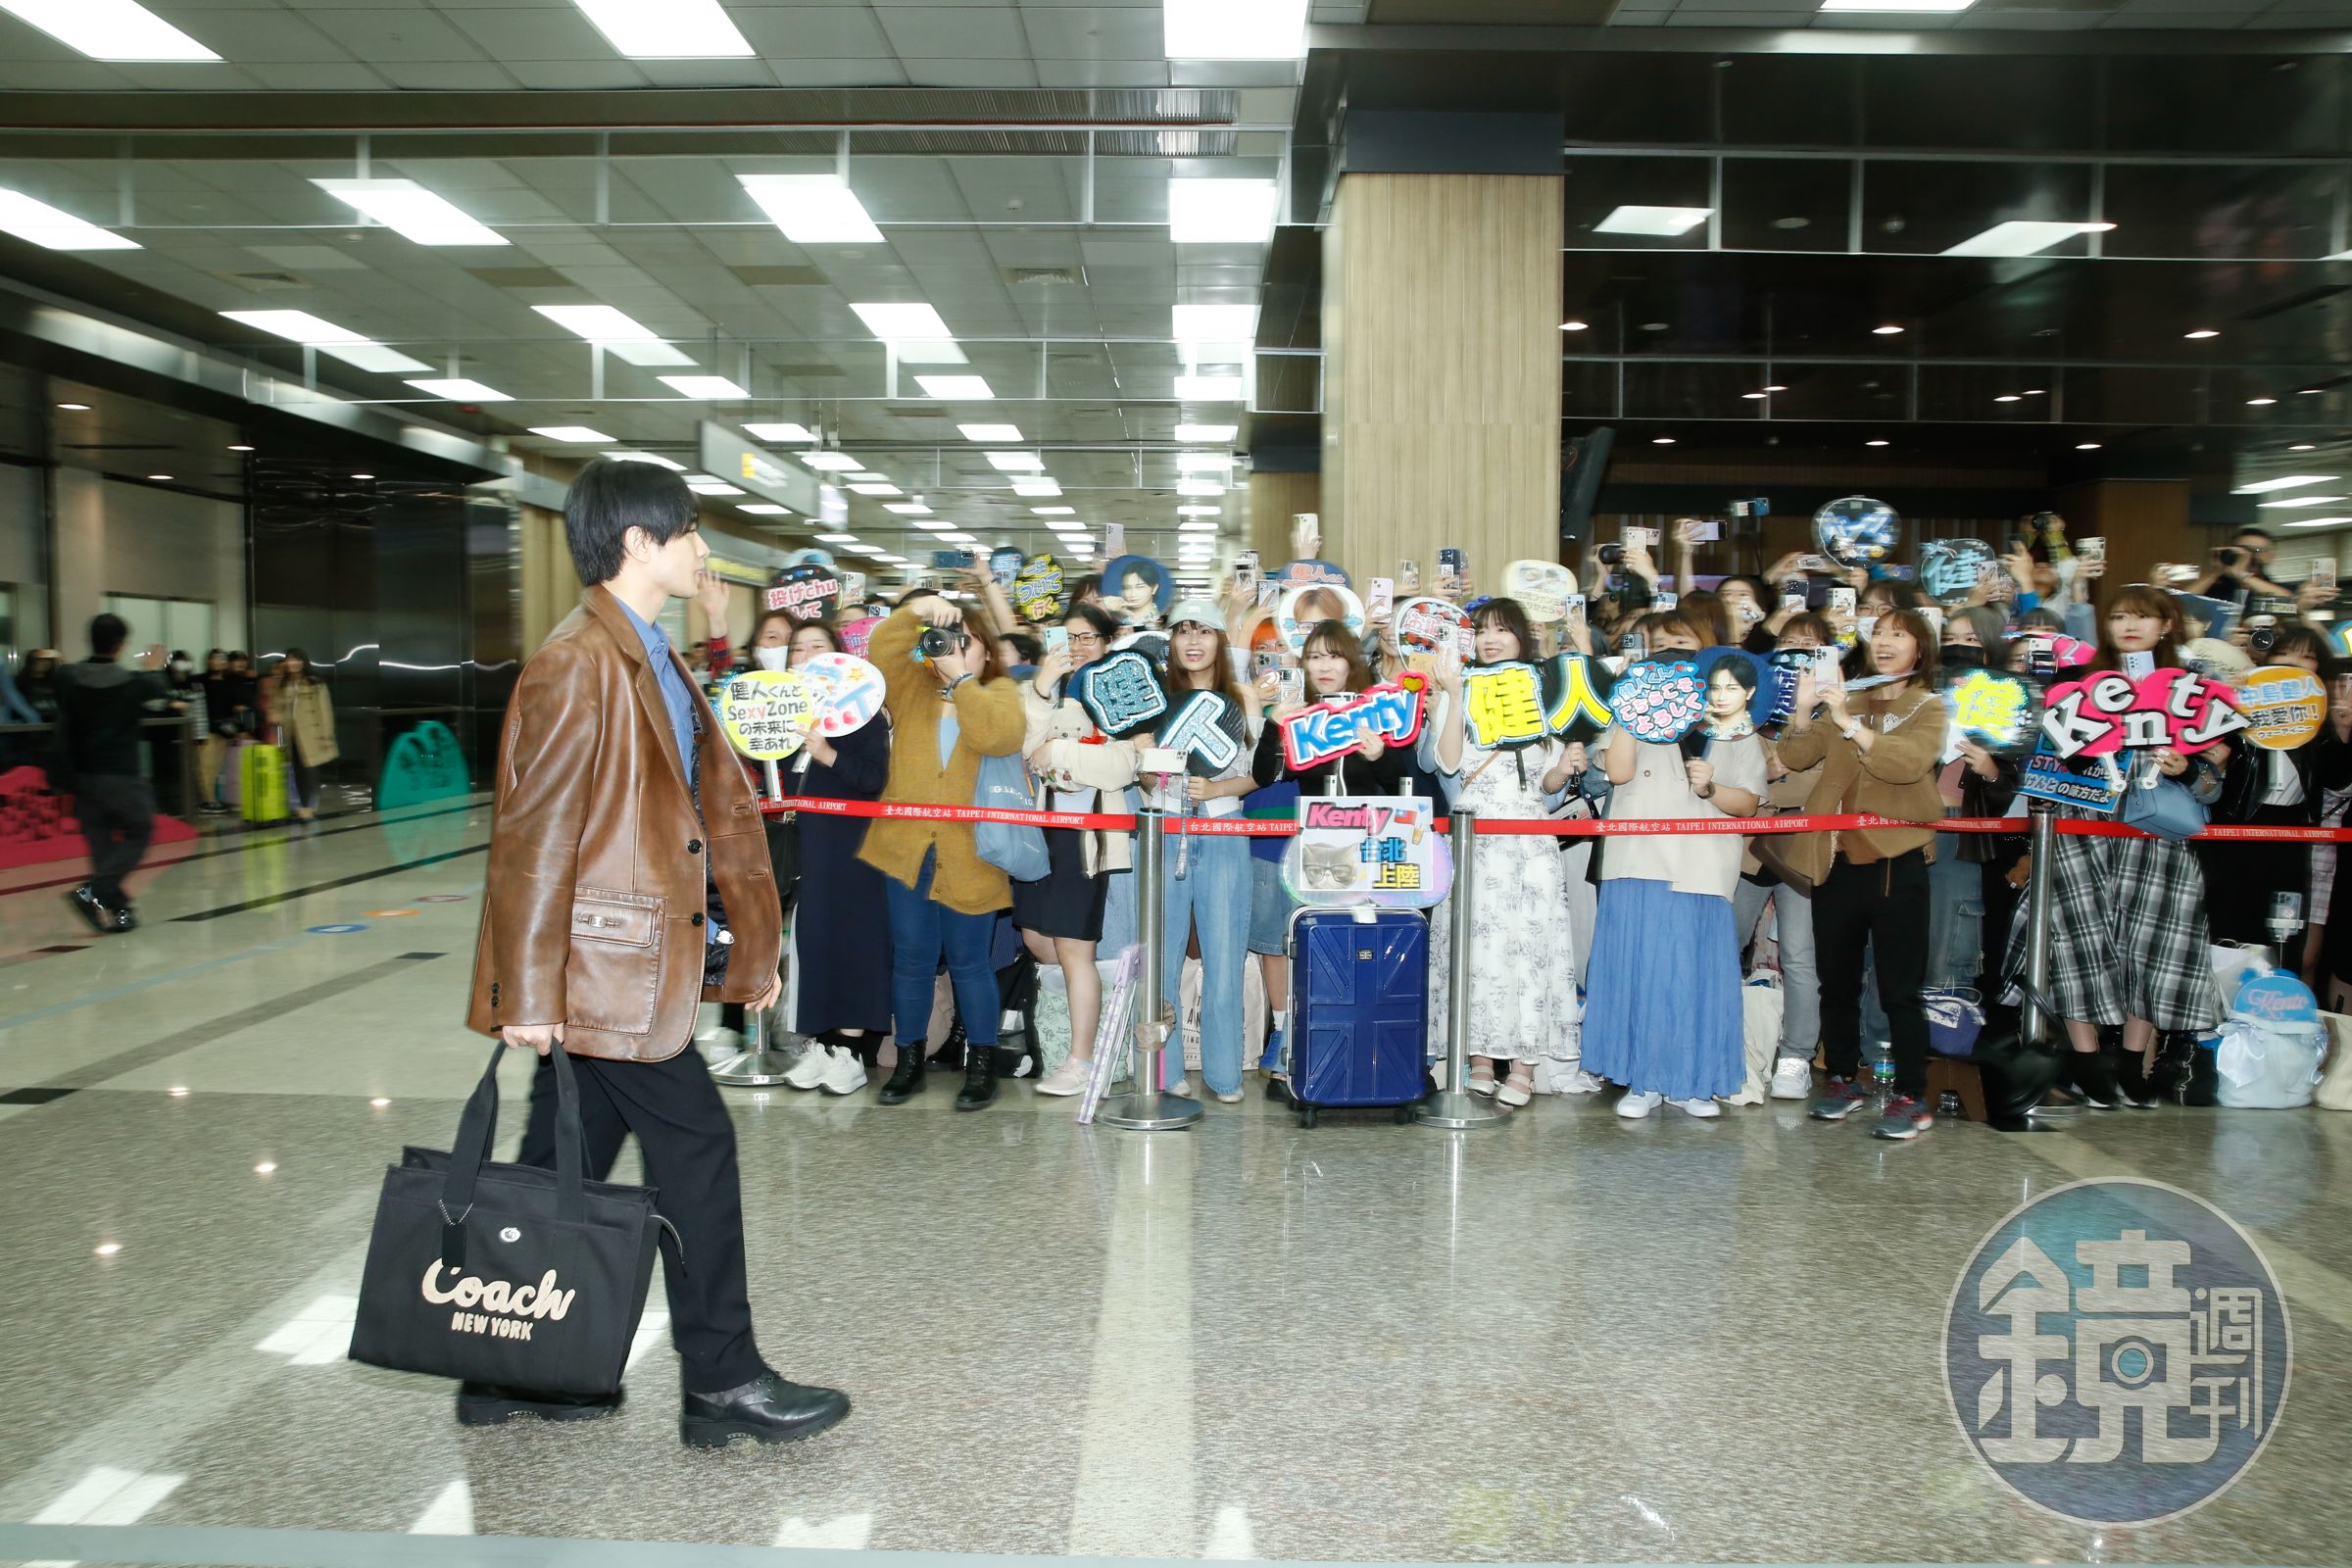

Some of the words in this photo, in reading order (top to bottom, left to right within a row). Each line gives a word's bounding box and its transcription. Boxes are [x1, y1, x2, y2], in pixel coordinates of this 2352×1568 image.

[767, 578, 839, 612] 投げchu
[1017, 570, 1062, 605] ついて
[1033, 597, 1054, 619] 行く
[730, 680, 804, 702] 健人くんと
[1467, 666, 1546, 746] 健
[1549, 657, 1613, 733] 人
[1619, 676, 1694, 722] こちらこそ
[739, 719, 797, 736] の未来に
[1291, 688, 1421, 765] Kenty
[1636, 691, 1704, 735] よろしく
[2042, 672, 2251, 760] Kenty
[749, 736, 792, 753] 幸あれ
[817, 800, 848, 811] AIRPORT
[956, 808, 985, 819] TAIPEI
[987, 809, 1049, 824] INTERNATIONAL
[1050, 815, 1086, 826] AIRPORT
[1306, 800, 1395, 836] Kenty
[1189, 820, 1267, 833] 台北國際航空站
[1269, 822, 1298, 833] TAIPEI
[1675, 820, 1706, 832] TAIPEI
[1707, 818, 1772, 831] INTERNATIONAL
[1774, 817, 1809, 829] AIRPORT
[2213, 827, 2241, 838] TAIPEI
[2241, 828, 2302, 838] INTERNATIONAL
[2303, 830, 2336, 840] AIRPORT
[1360, 836, 1409, 862] 台北
[1374, 862, 1422, 890] 上陸
[421, 1257, 576, 1321] Coach
[452, 1310, 489, 1335] NEW
[491, 1316, 534, 1342] YORK
